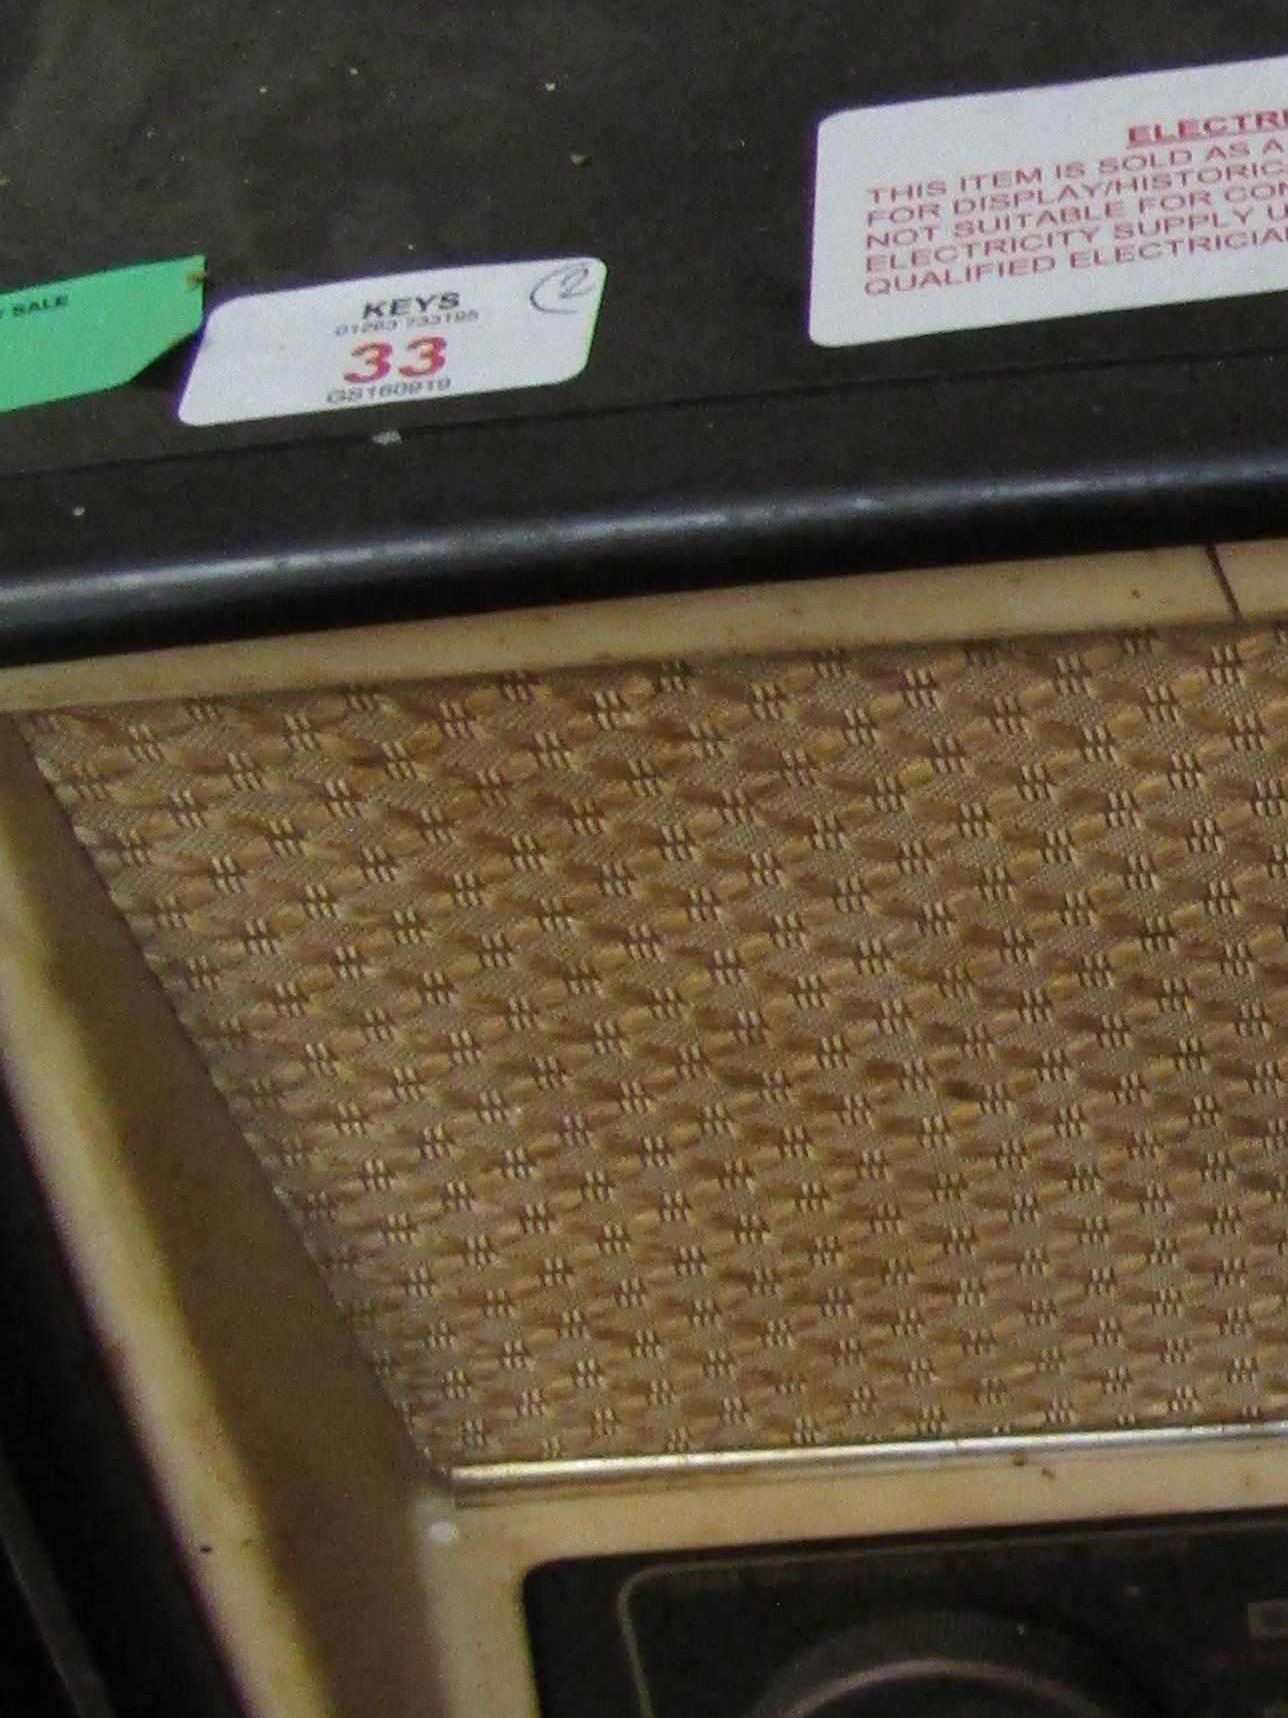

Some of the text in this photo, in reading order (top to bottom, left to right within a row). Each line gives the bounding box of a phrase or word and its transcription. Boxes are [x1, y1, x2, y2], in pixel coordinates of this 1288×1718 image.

[868, 180, 947, 204] THIS
[959, 167, 1043, 193] ITEM
[1056, 161, 1086, 182] IS
[1098, 149, 1193, 174] SOLD
[1204, 142, 1251, 162] AS
[1262, 137, 1285, 155] A
[865, 226, 936, 251] NOT
[953, 199, 1125, 240] SUITABLE
[1138, 190, 1212, 215] FOR
[866, 203, 942, 228] FOR
[864, 226, 1101, 274] ELECTRICITY
[1112, 206, 1254, 240] SUPPLY
[864, 253, 1057, 297] QUALIFIED
[13, 293, 71, 317] SALE
[361, 290, 461, 320] KEYS
[344, 335, 449, 385] 33
